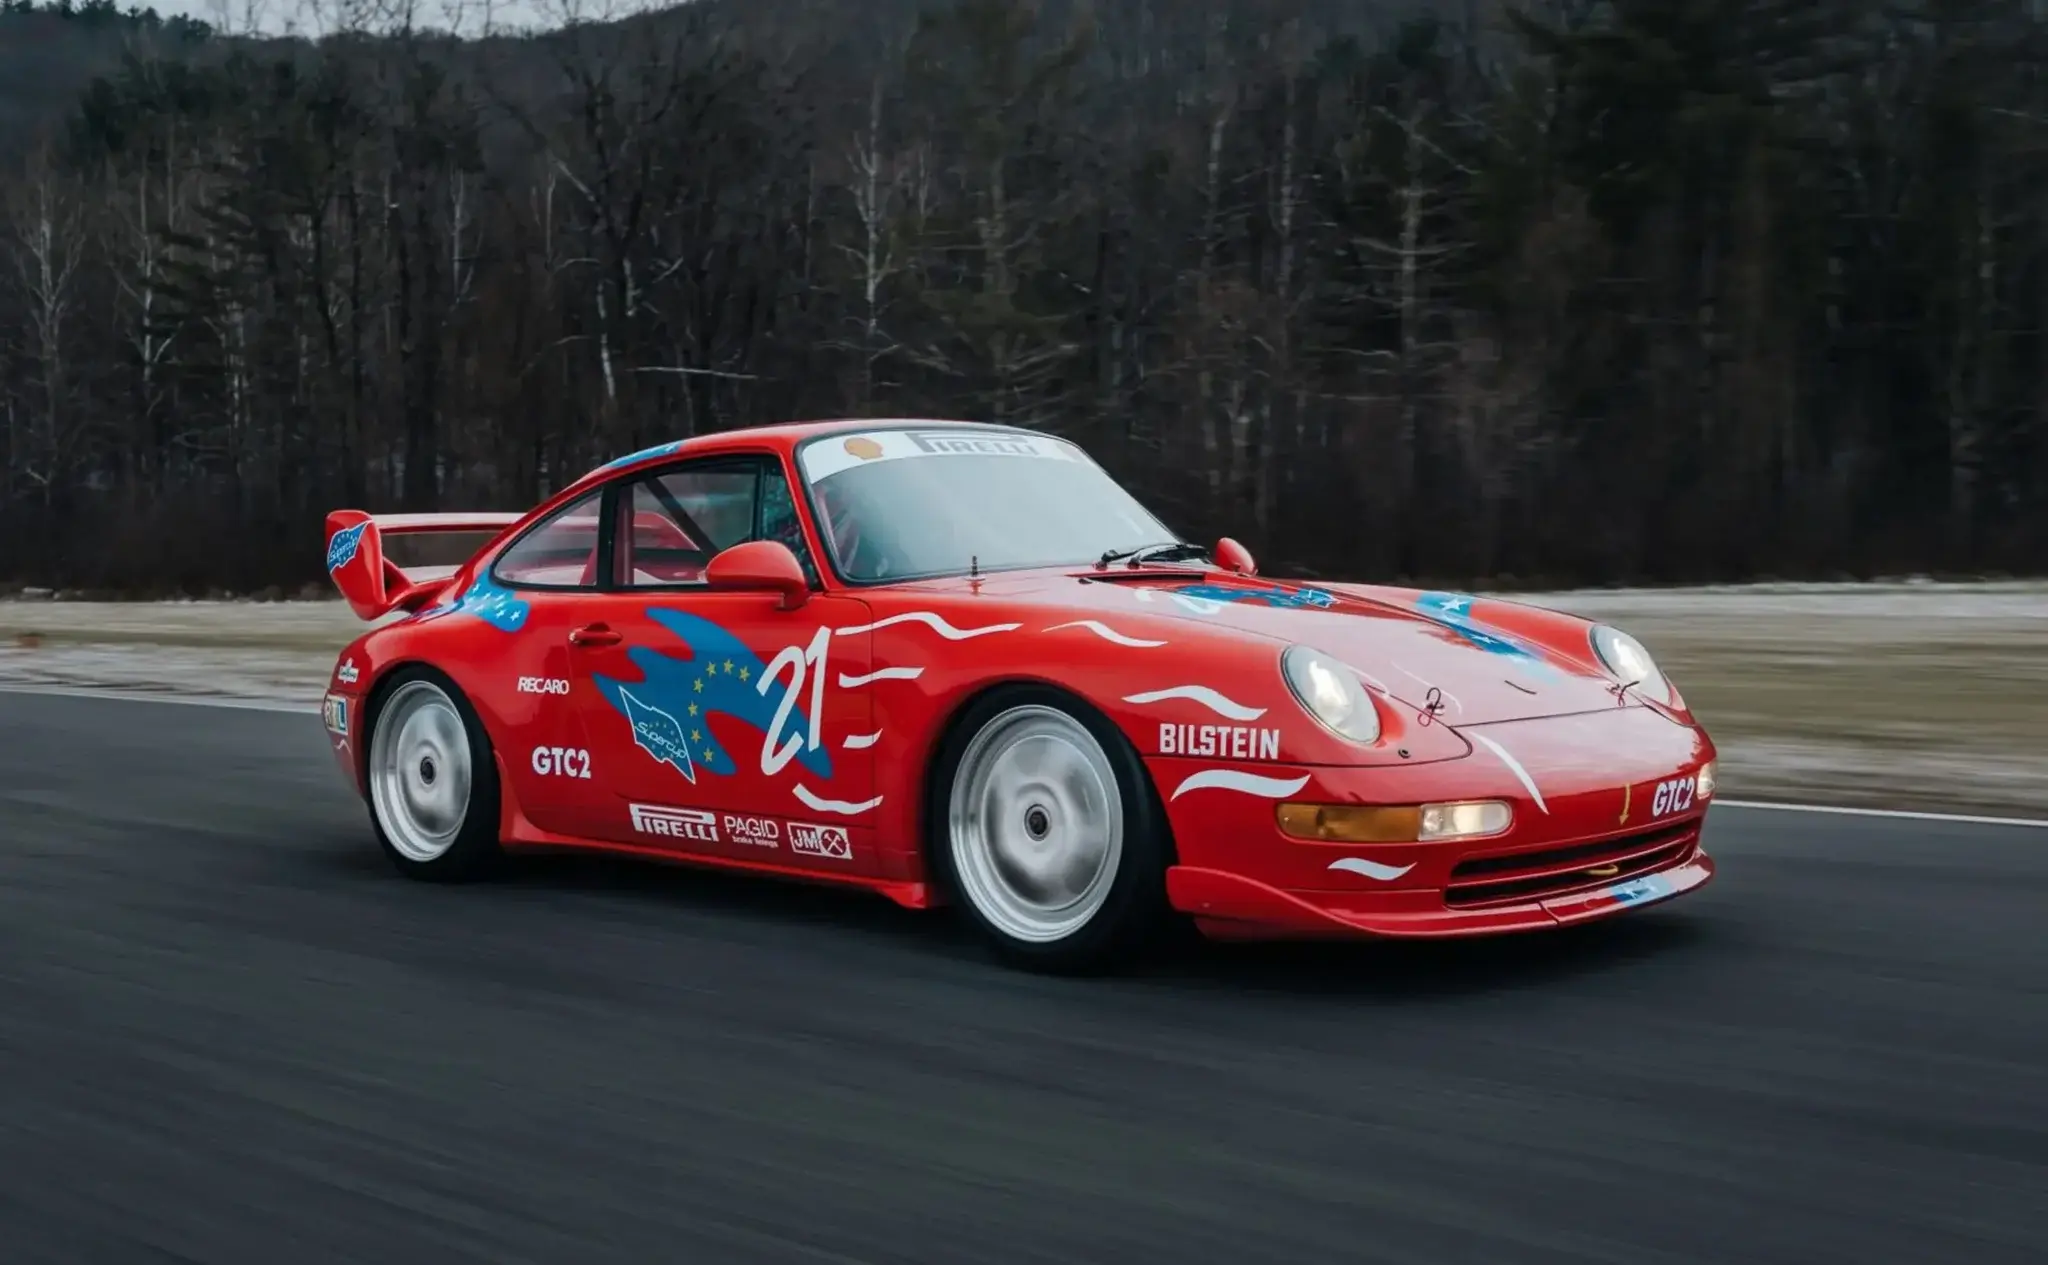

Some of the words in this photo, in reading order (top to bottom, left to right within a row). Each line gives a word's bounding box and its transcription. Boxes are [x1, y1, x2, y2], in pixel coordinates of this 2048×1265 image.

[905, 432, 1039, 455] PIRELLI
[517, 676, 570, 695] RECARO
[756, 625, 831, 776] 21
[634, 721, 688, 759] Supercup
[1160, 723, 1279, 759] BILSTEIN
[532, 746, 591, 779] GTC2
[1652, 777, 1695, 816] GTC2
[629, 803, 719, 842] PIRELLI
[724, 815, 779, 839] PAGID
[795, 829, 820, 850] JM
